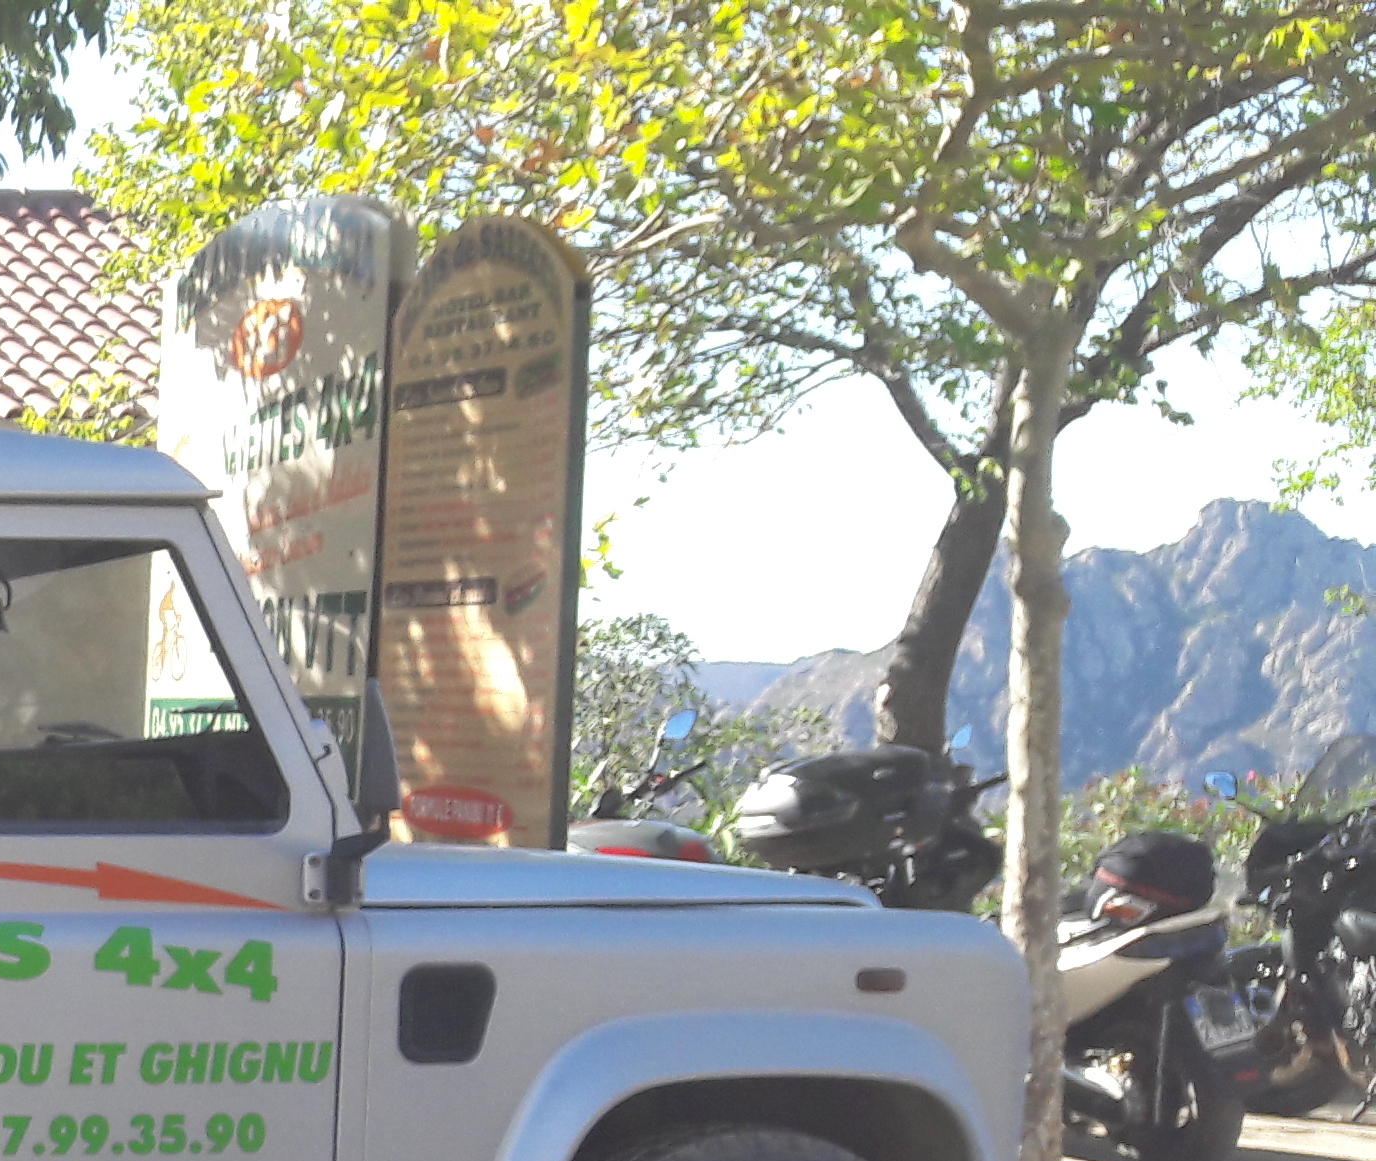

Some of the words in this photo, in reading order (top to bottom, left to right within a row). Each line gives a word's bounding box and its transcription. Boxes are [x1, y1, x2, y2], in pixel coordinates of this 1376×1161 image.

[94, 926, 278, 1002] 4x4
[69, 1042, 127, 1086] ET
[140, 1041, 334, 1085] GHIGNU
